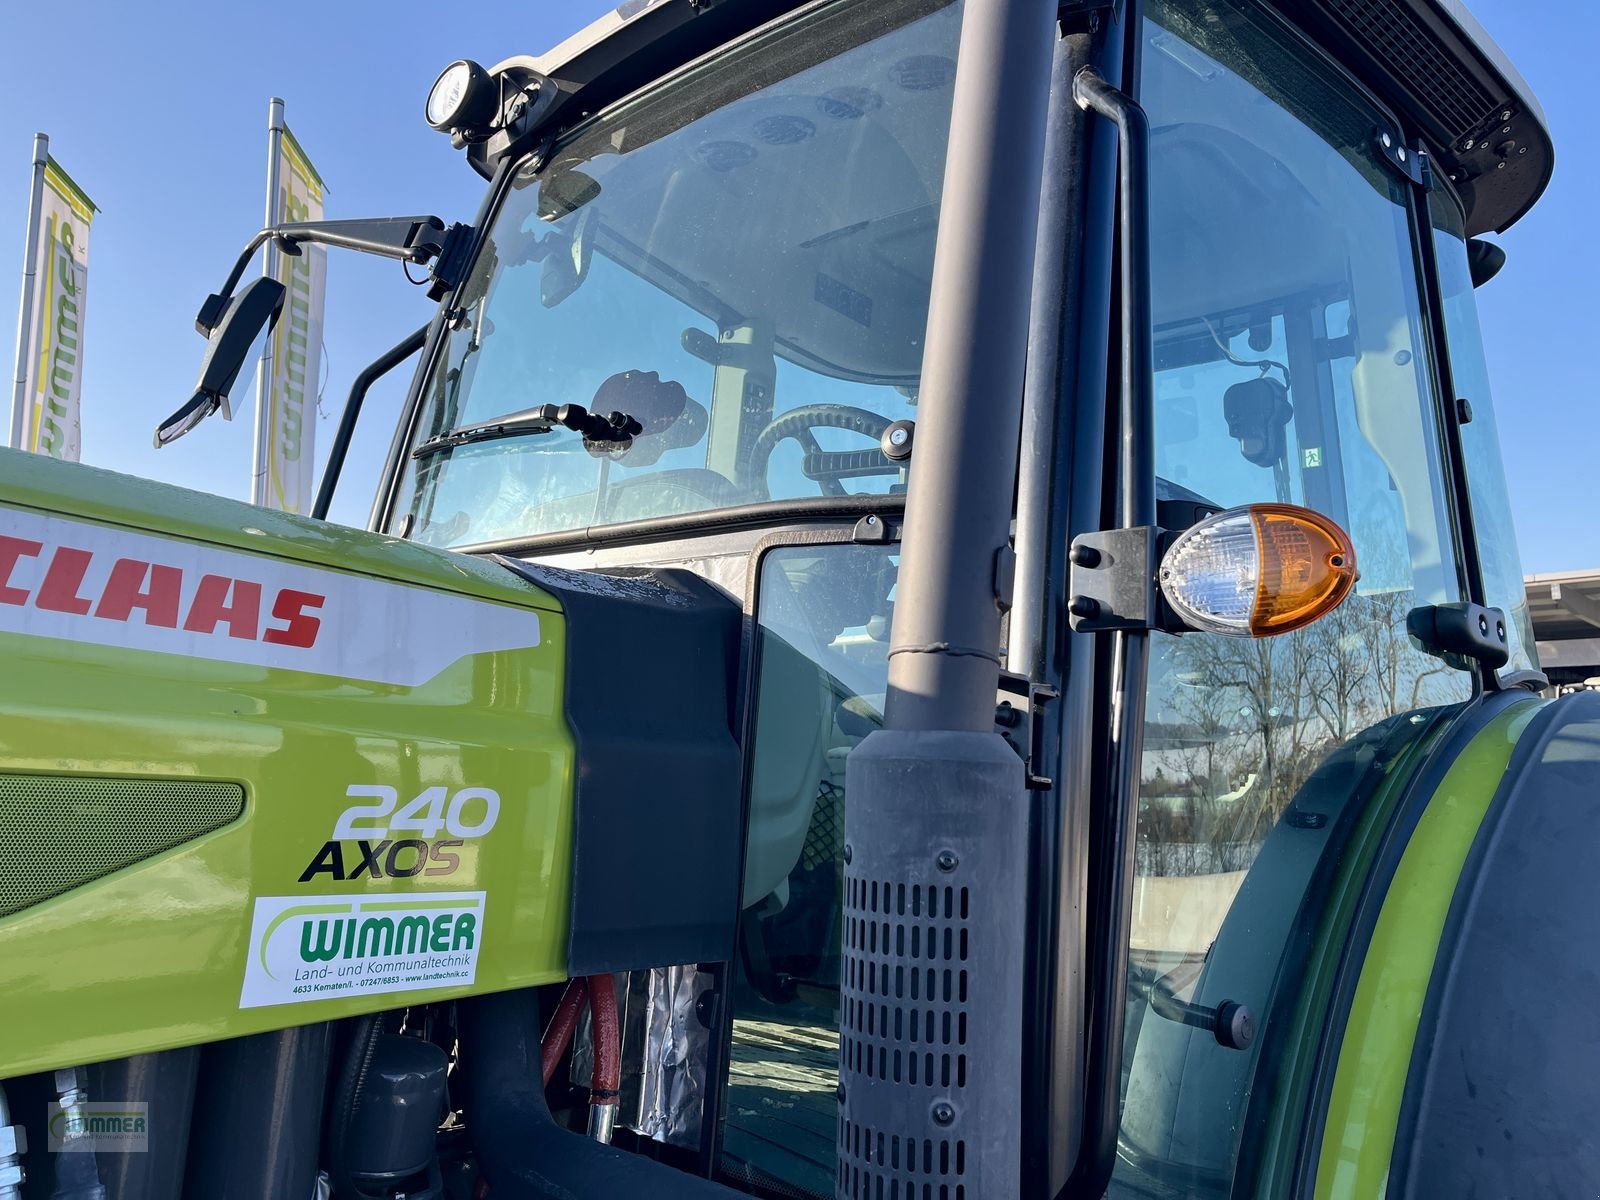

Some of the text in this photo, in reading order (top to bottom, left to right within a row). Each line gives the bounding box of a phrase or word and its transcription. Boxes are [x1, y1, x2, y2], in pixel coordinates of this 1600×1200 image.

[0, 535, 326, 649] CLAAS
[332, 784, 501, 840] 240
[297, 839, 464, 883] AXOS
[300, 912, 476, 963] WIMMER
[292, 984, 312, 994] 4633
[360, 976, 400, 987] 07247/6853
[405, 970, 469, 982] www.landtechnik.cc
[294, 954, 471, 981] Land- und Kommunaltechnik
